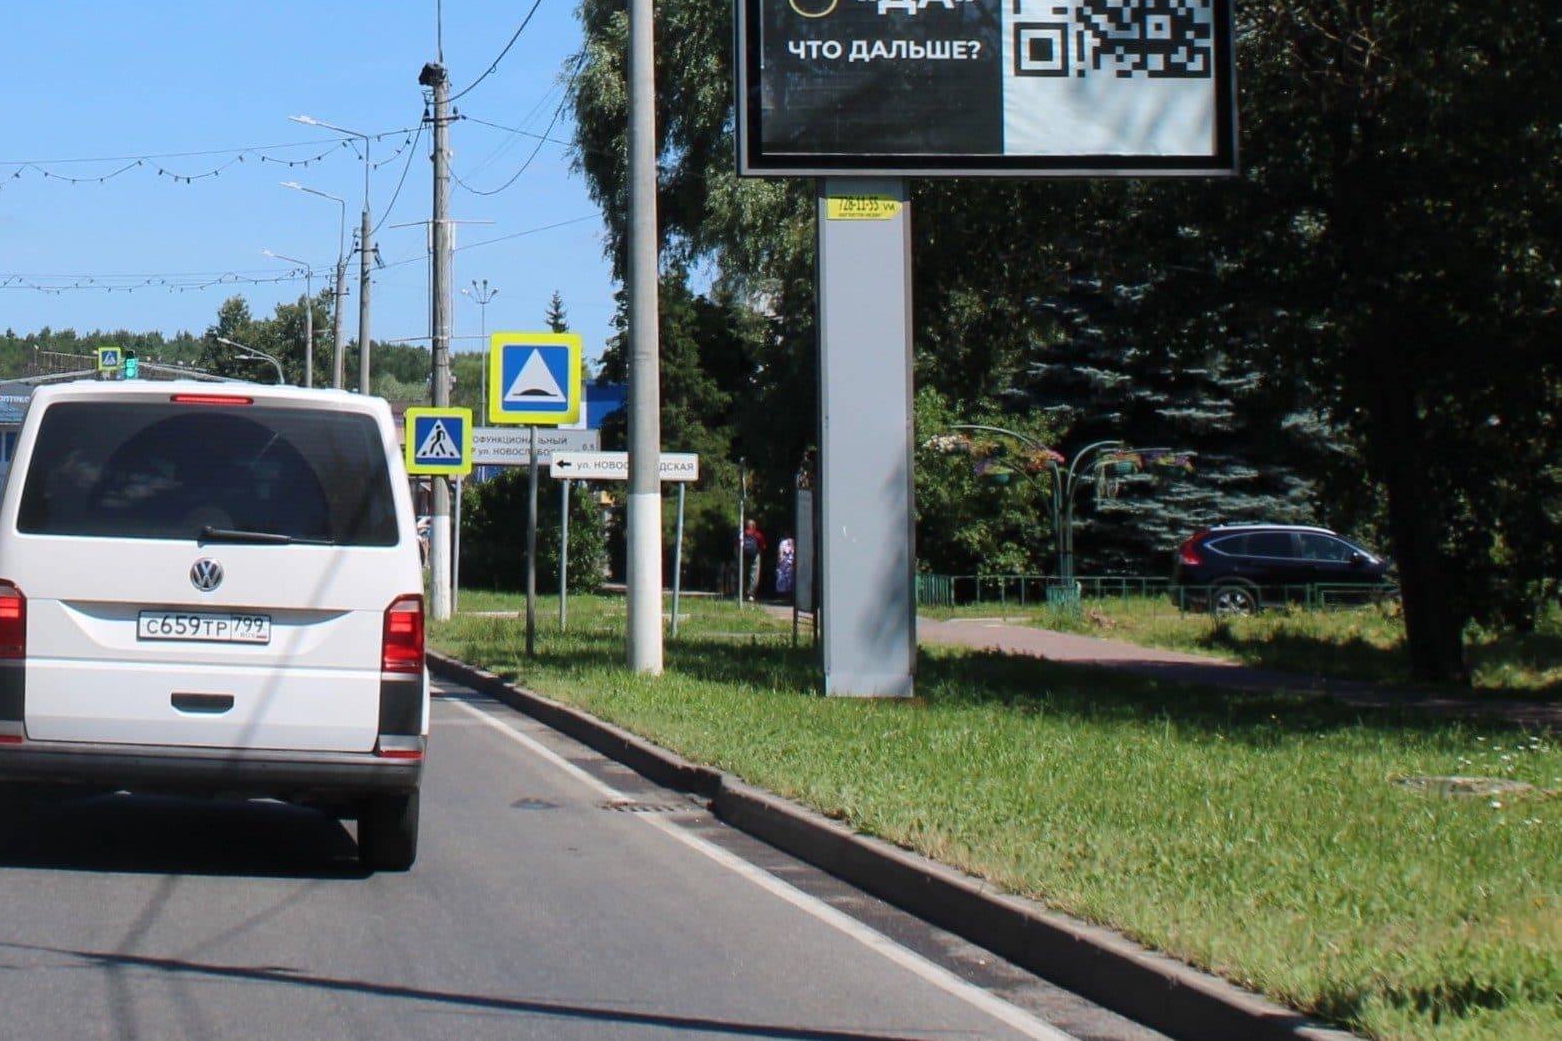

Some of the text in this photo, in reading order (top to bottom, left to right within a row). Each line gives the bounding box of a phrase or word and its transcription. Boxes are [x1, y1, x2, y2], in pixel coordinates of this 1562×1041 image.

[788, 40, 982, 63] ЧТО ДАЛЬШЕ?
[146, 614, 263, 636] С659ТР 799
